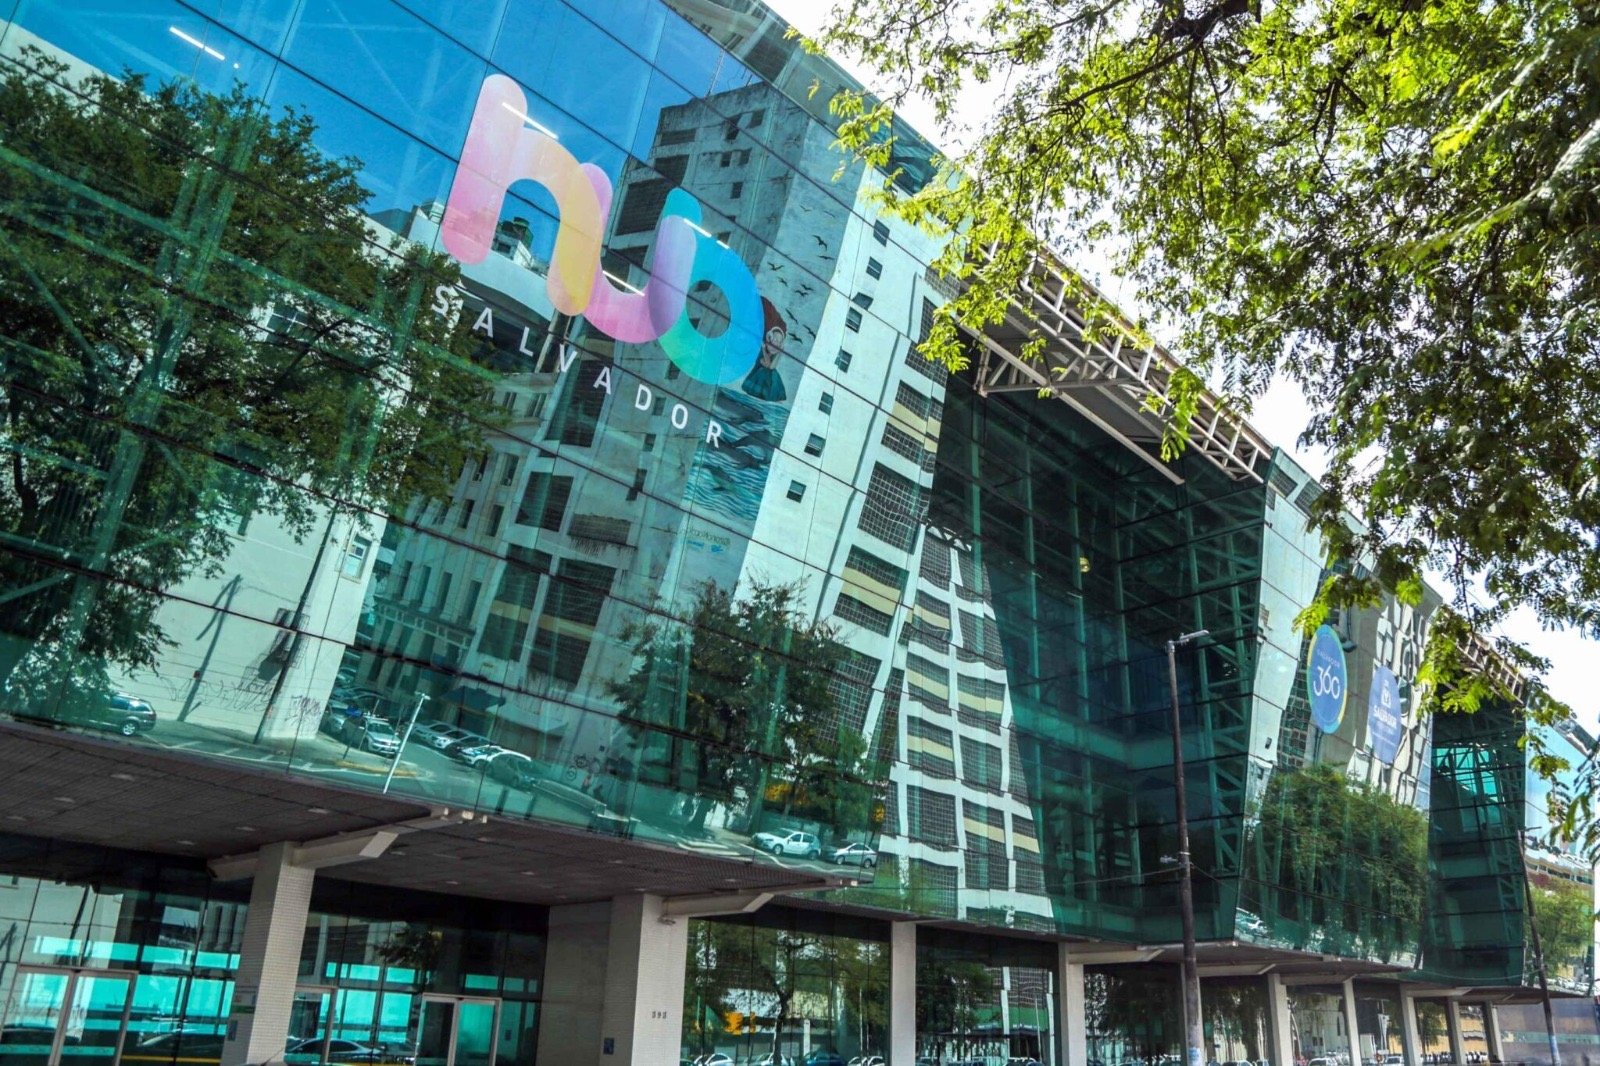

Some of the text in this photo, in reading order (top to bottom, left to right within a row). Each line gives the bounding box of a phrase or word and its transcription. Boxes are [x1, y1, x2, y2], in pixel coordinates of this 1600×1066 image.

[441, 73, 764, 385] hub
[431, 285, 723, 448] SALVADOR
[1313, 665, 1340, 700] 360
